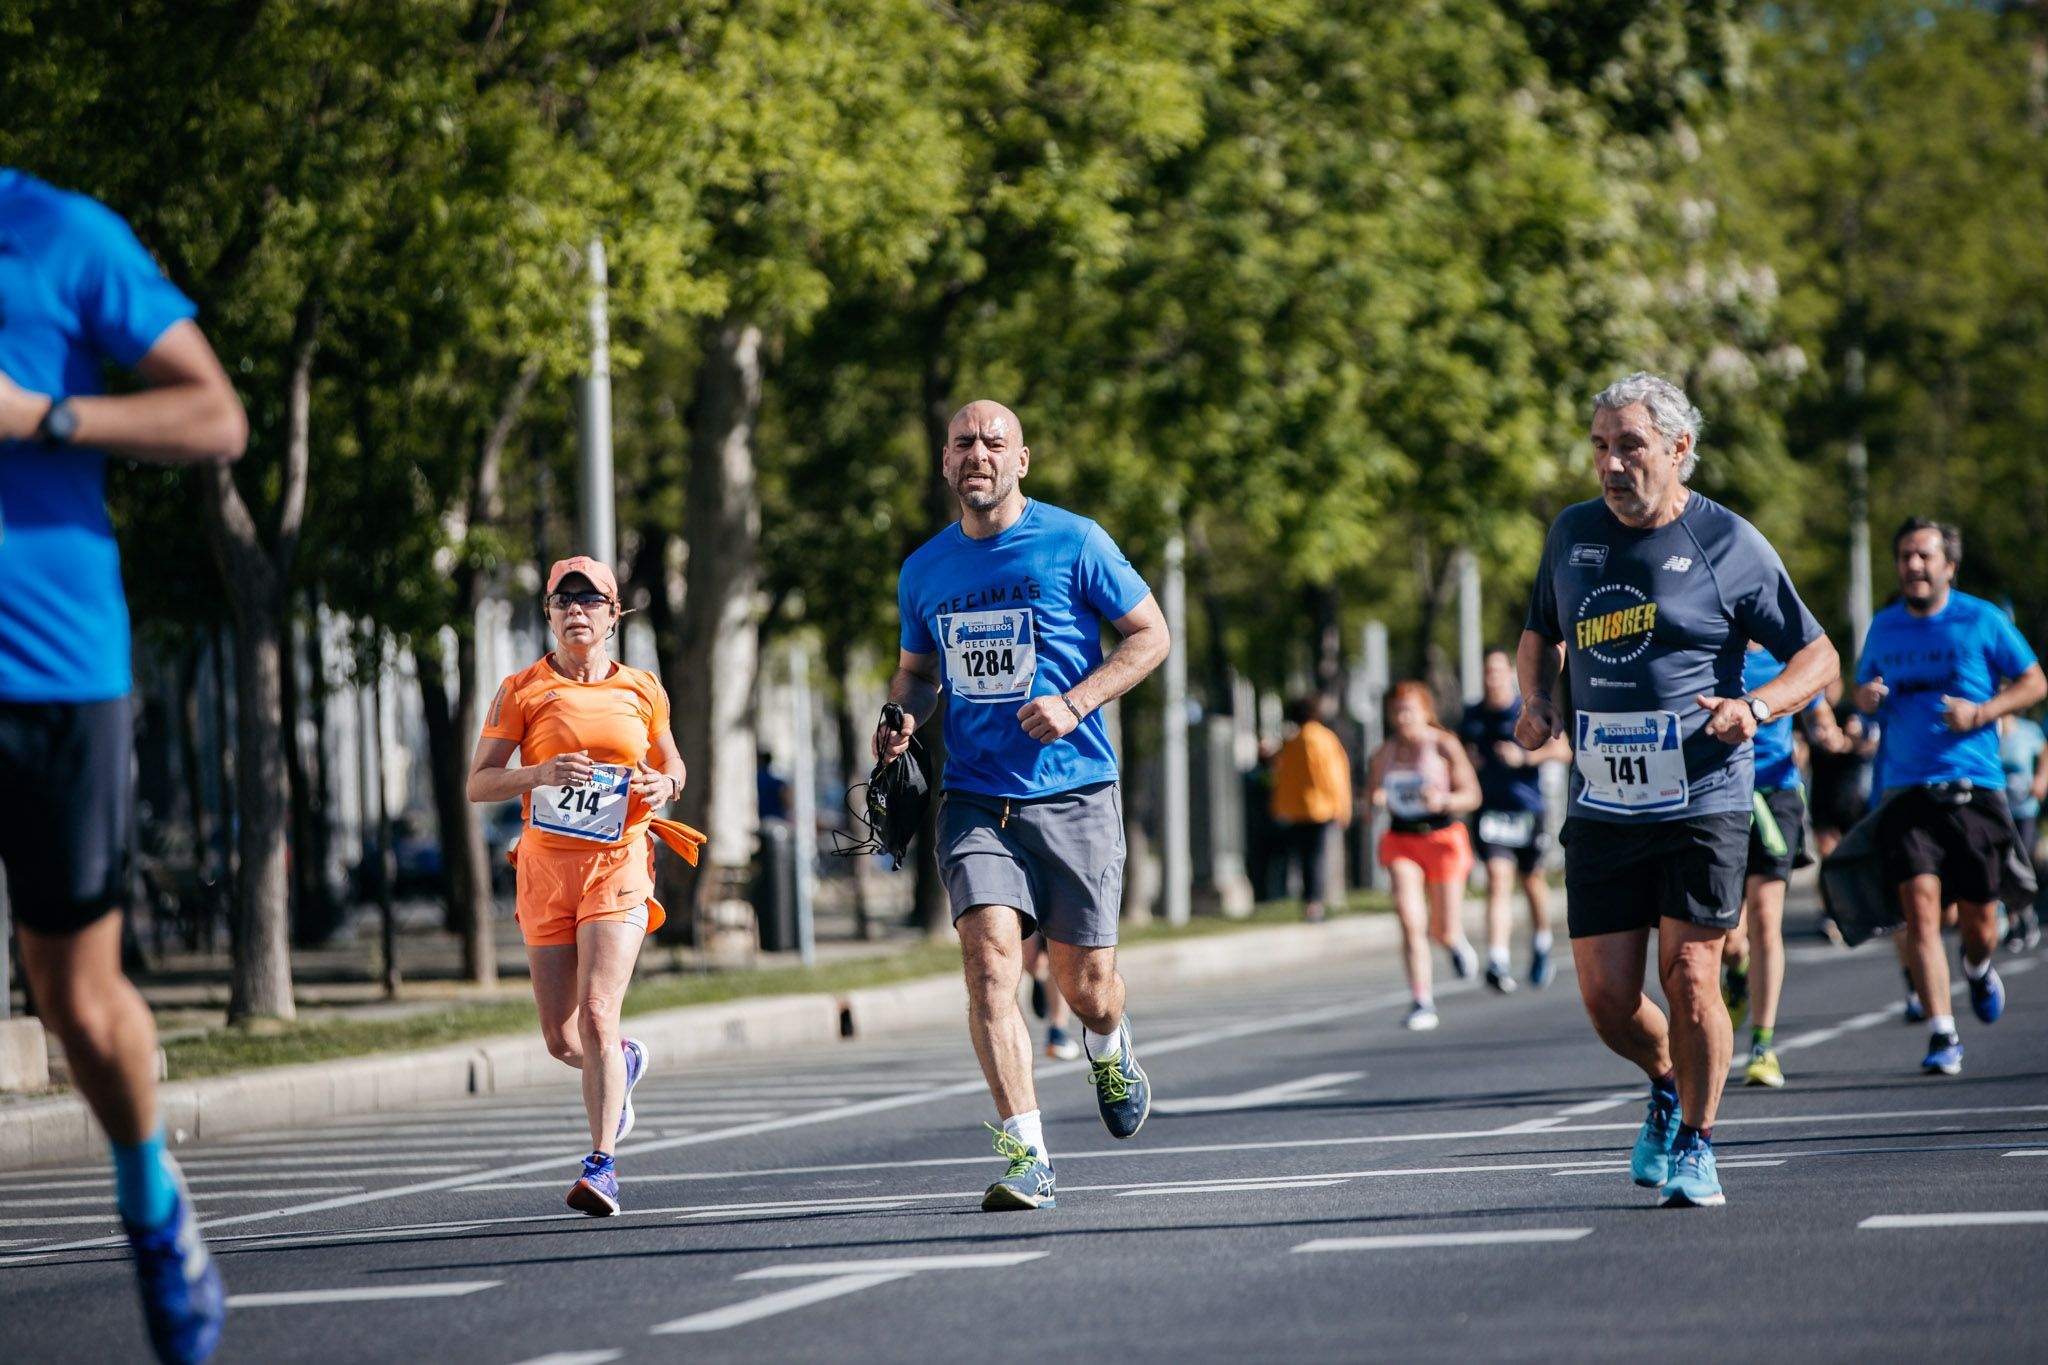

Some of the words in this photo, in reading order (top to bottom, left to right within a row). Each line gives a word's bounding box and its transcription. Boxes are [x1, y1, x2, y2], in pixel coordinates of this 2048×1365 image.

[937, 583, 1040, 614] DECIMAS
[968, 624, 1013, 633] BOMBEROS
[965, 639, 1012, 648] DECIMAS
[962, 649, 1015, 677] 1284
[1604, 727, 1656, 736] BOMBEROS
[1601, 744, 1657, 753] DECIMAS
[1604, 755, 1649, 785] 741
[558, 785, 600, 816] 214
